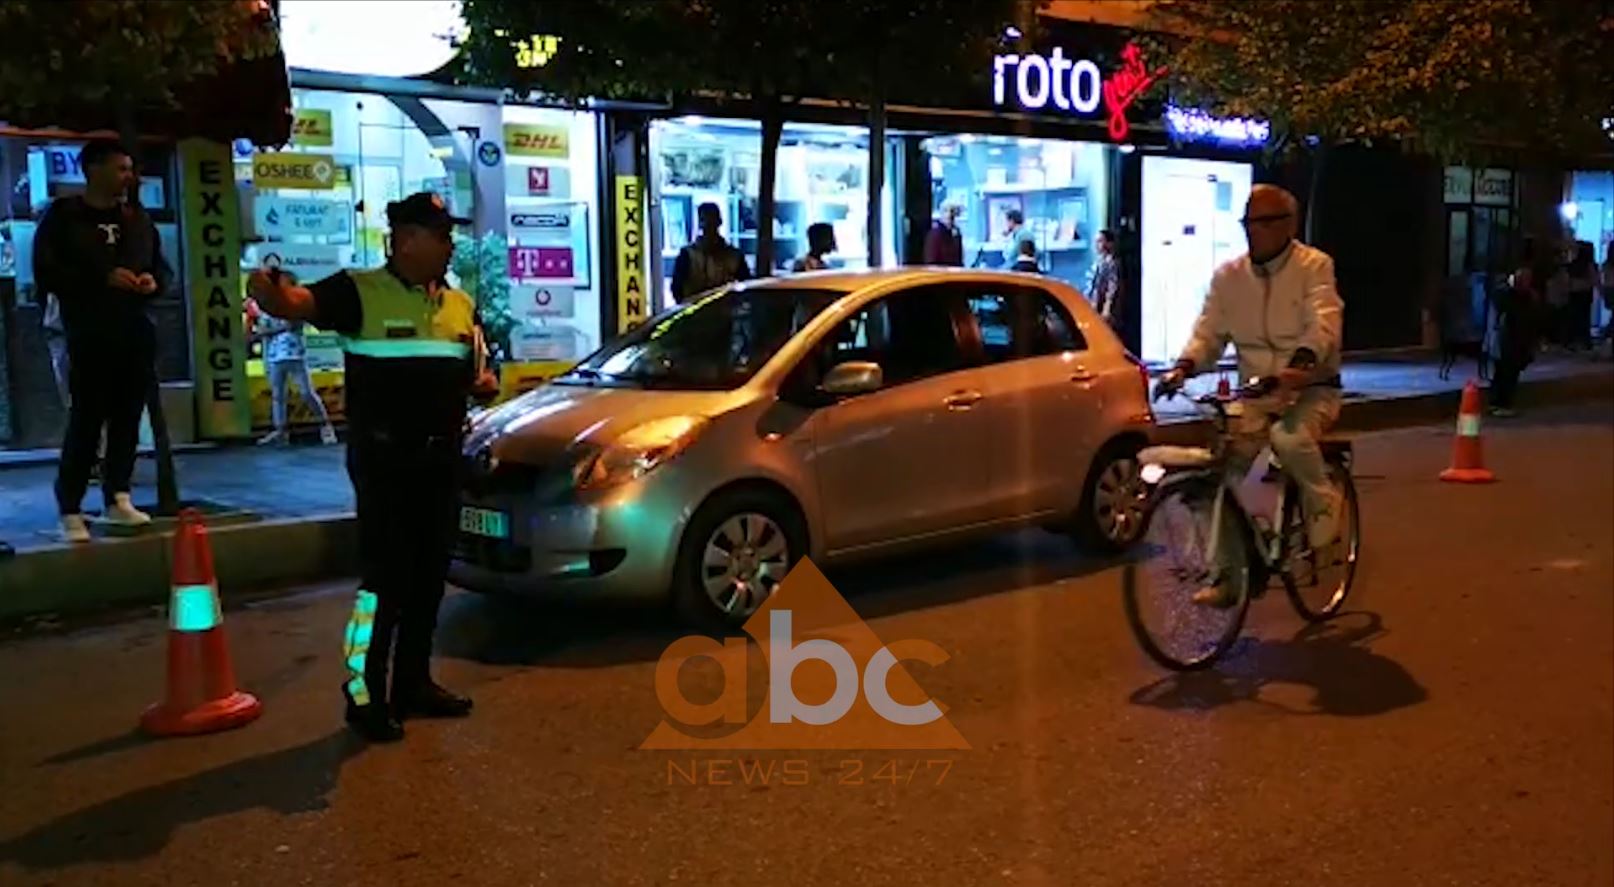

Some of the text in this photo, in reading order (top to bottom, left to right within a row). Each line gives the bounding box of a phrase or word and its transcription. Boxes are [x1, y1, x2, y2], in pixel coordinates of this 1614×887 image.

[512, 132, 562, 150] DHL
[257, 162, 313, 180] OSHEE
[199, 161, 234, 402] EXCHANGE
